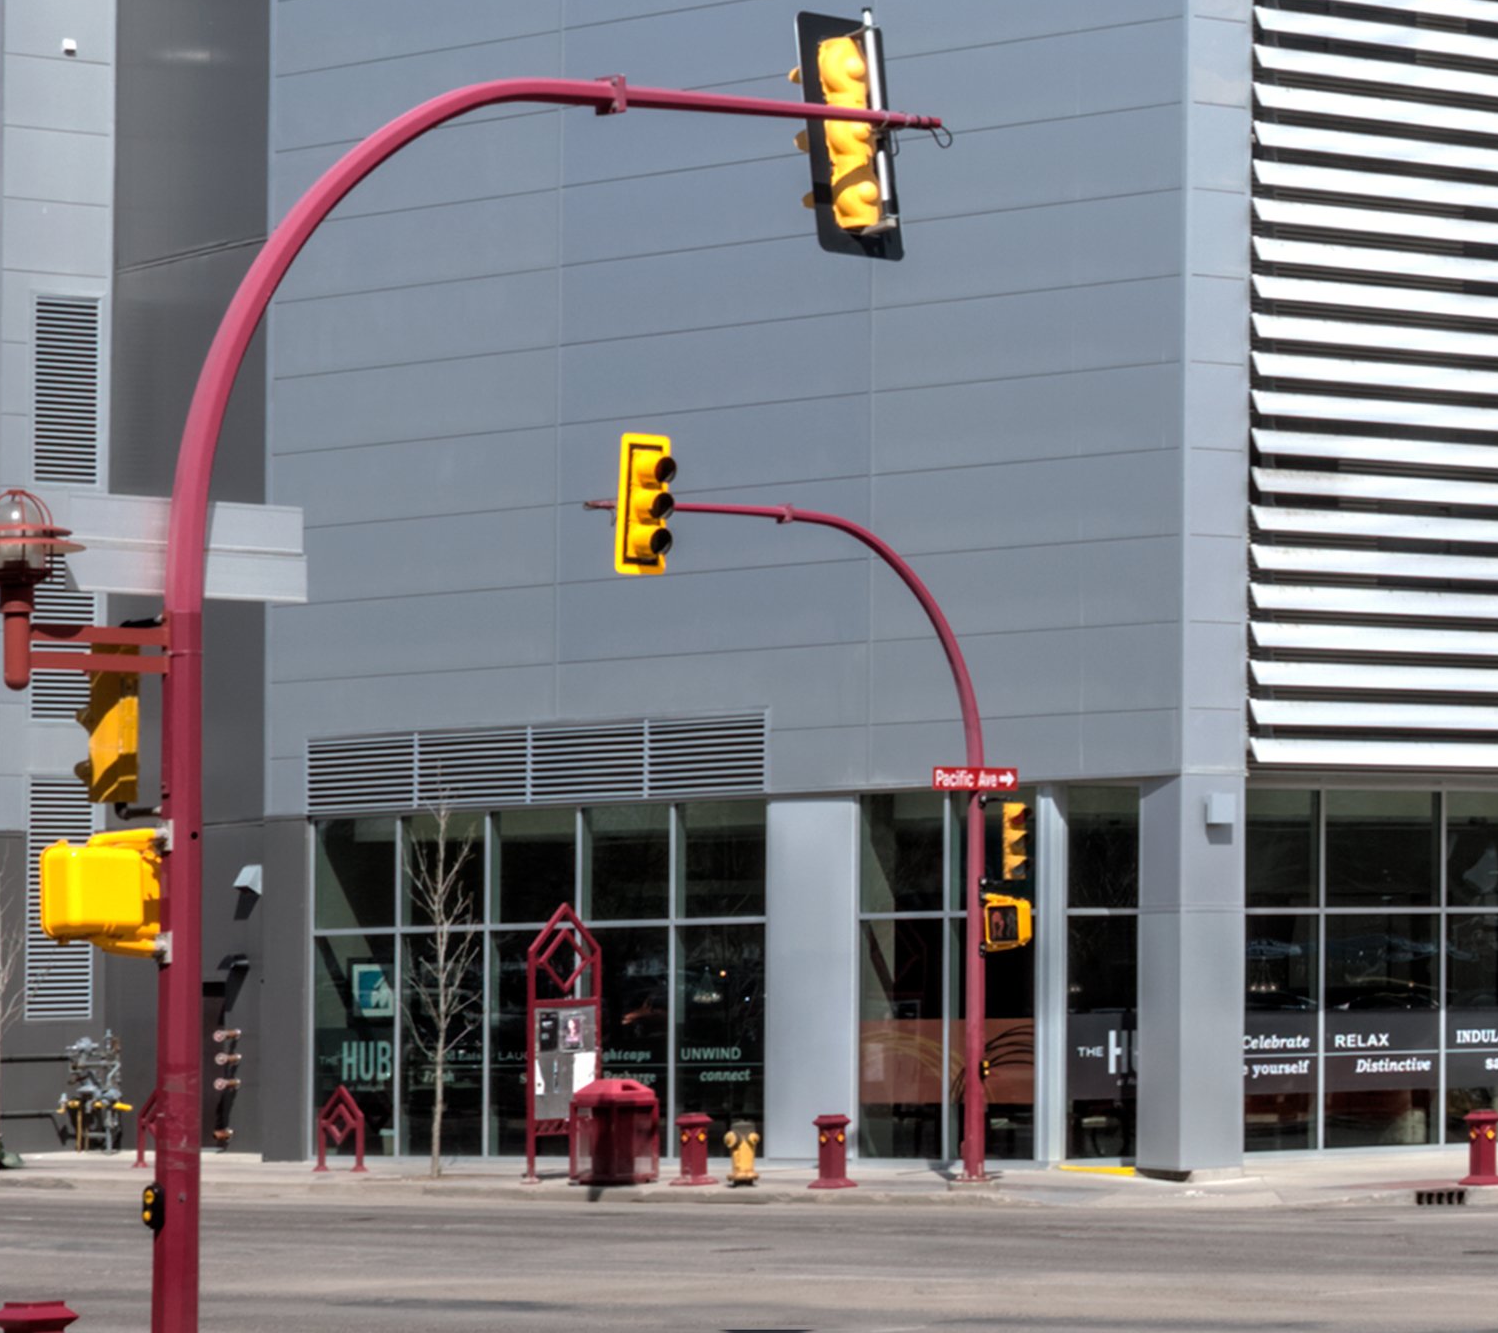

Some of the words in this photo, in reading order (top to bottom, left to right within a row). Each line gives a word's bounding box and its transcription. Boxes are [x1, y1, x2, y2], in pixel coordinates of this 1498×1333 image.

[935, 769, 974, 787] Pacific
[977, 770, 997, 787] Ave
[1242, 1034, 1310, 1050] Celebrate
[1334, 1034, 1389, 1048] RELAX
[681, 1047, 741, 1061] UNWIND
[1077, 1046, 1104, 1057] THE
[341, 1040, 392, 1082] HUB
[1252, 1059, 1310, 1079] yourself
[1355, 1057, 1432, 1073] Distinctive
[699, 1069, 751, 1082] connect
